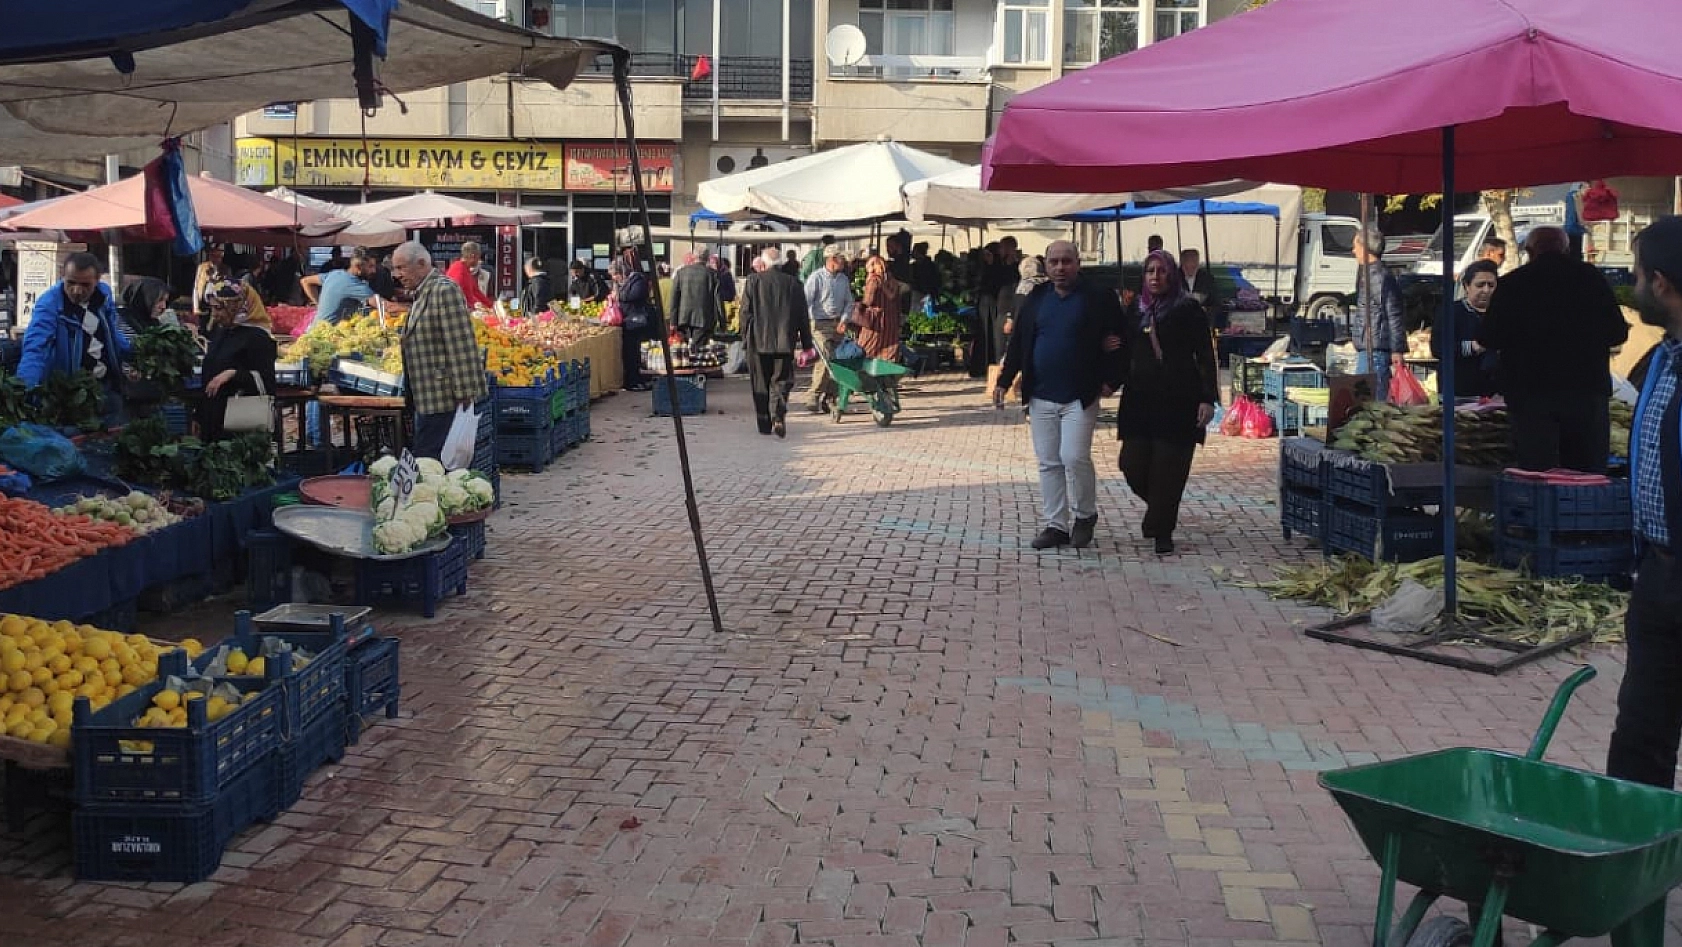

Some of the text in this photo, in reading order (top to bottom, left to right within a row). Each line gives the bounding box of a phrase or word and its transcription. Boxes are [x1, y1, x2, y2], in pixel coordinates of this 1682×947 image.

[302, 141, 409, 168] EMİNOĞLU
[416, 149, 463, 169] AVM
[470, 150, 486, 170] &
[492, 145, 549, 175] ÇEYİZ
